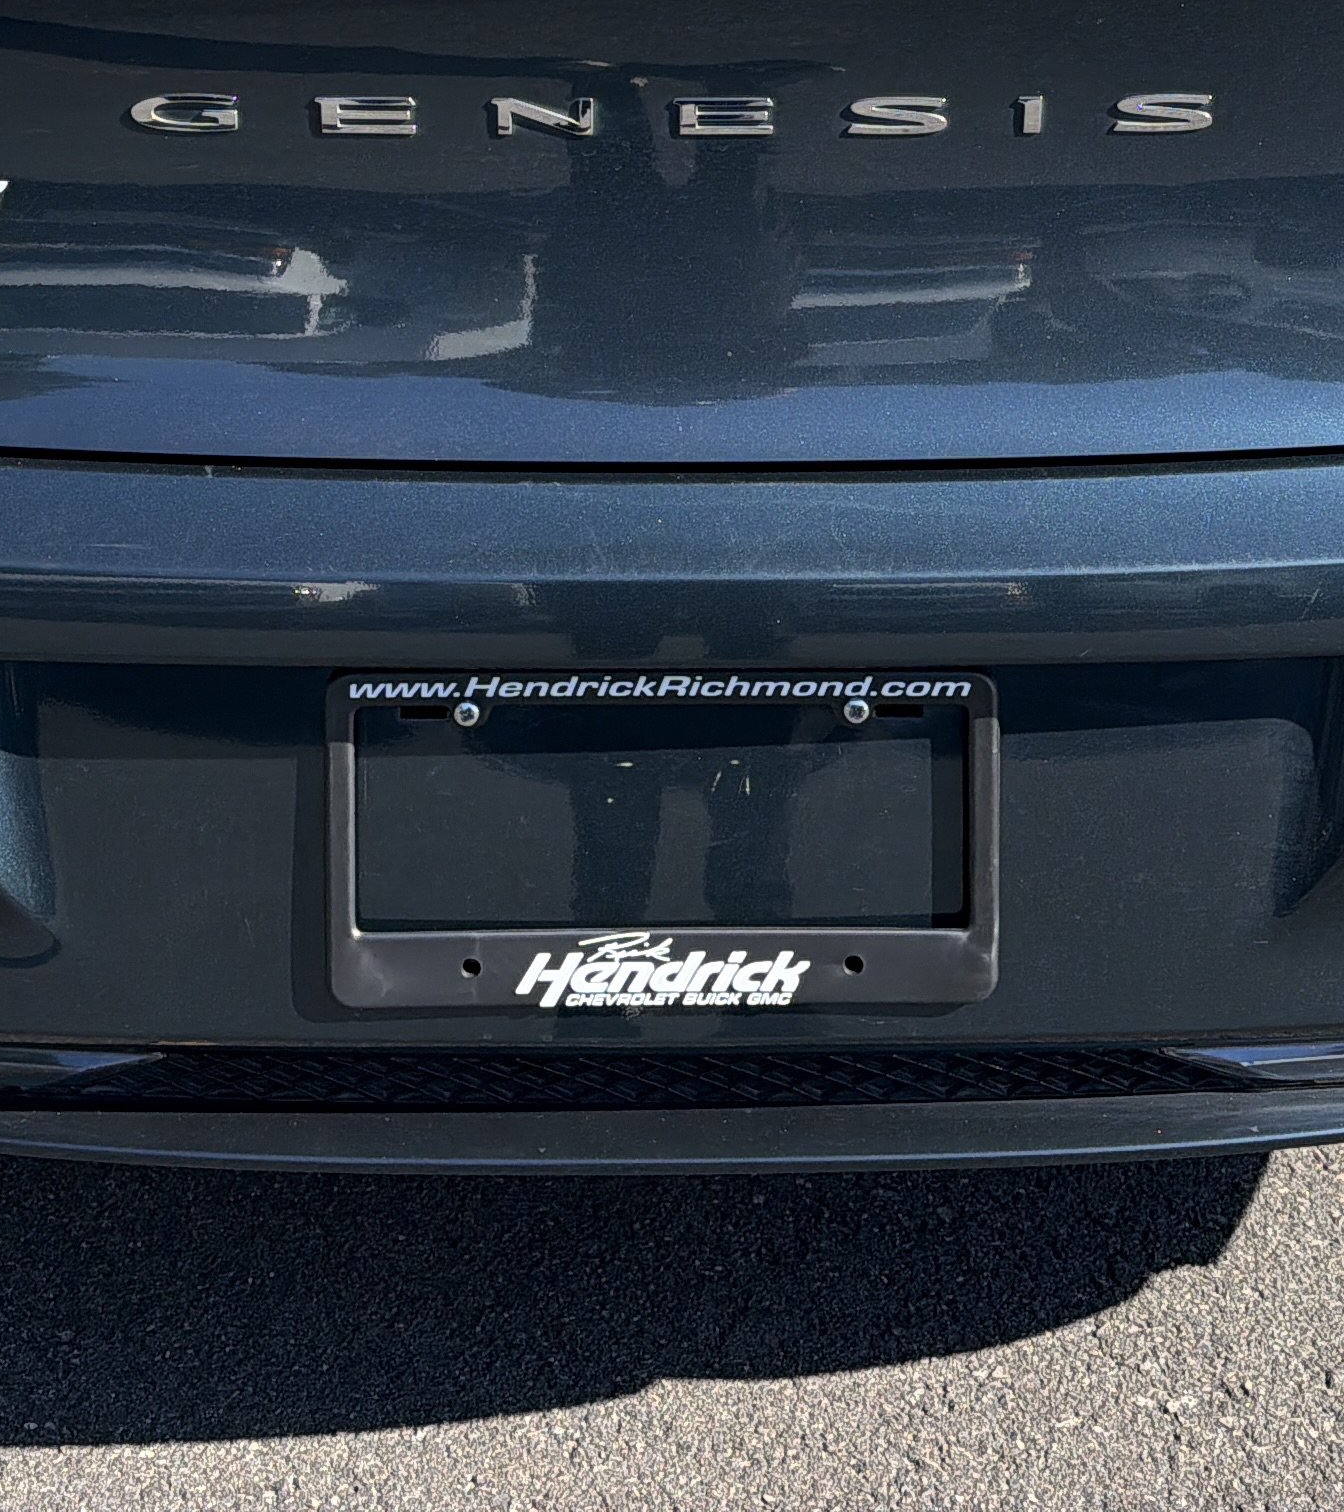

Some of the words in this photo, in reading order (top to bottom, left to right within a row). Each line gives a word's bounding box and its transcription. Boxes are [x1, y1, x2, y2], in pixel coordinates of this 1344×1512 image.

[130, 92, 1214, 136] GENESIS
[349, 675, 972, 699] www.HendrickRichmond.com
[578, 931, 674, 963] Rick
[514, 950, 811, 1008] Hendrick
[565, 992, 679, 1007] CHEVROLET
[682, 992, 741, 1006] BUICK
[746, 991, 793, 1006] GMC
